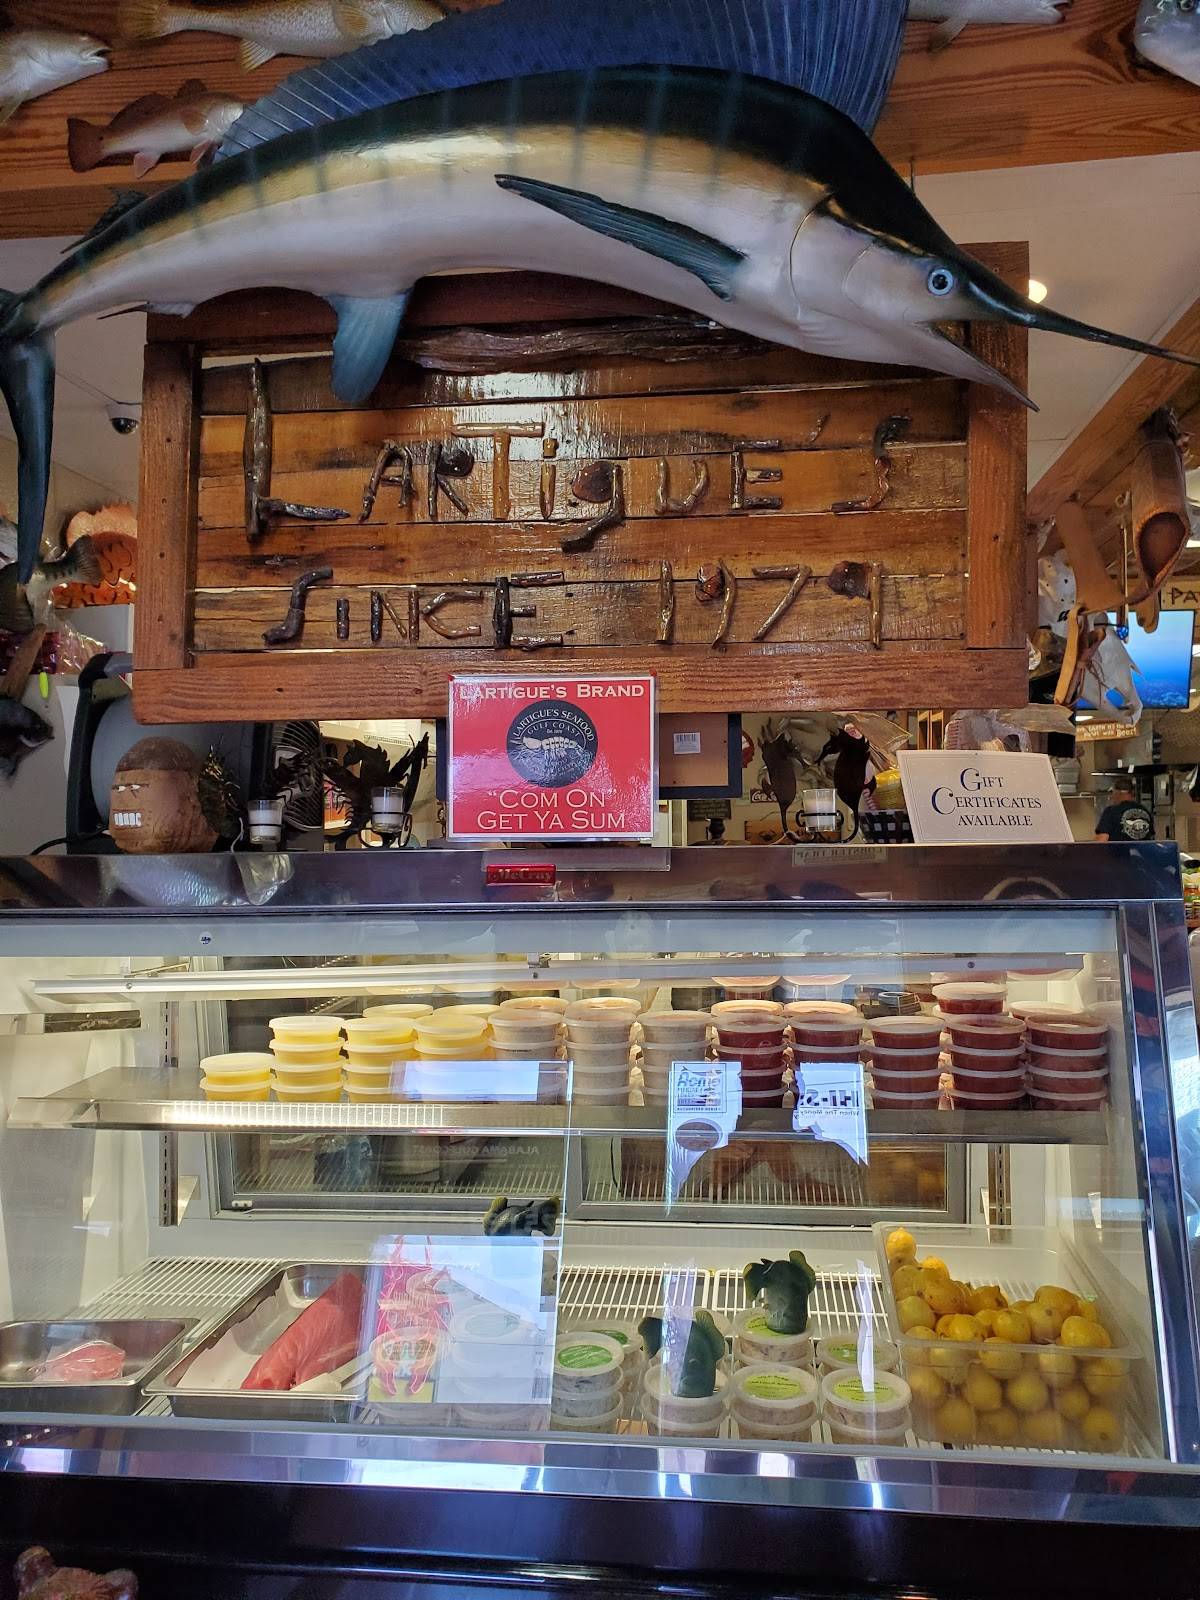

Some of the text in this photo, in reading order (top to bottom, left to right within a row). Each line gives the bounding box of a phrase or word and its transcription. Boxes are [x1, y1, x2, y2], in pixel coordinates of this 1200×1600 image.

[261, 569, 565, 650] SINCE
[459, 684, 645, 699] LARTIGUE'S BRAND
[512, 708, 595, 741] LARTIGUE'S SEAFOOD
[527, 721, 580, 737] GULF COAST
[960, 767, 1004, 792] GIFT
[931, 787, 1042, 815] CERTIFICATES
[477, 809, 626, 830] GET YA SUM
[958, 814, 1033, 827] AVAILABLE
